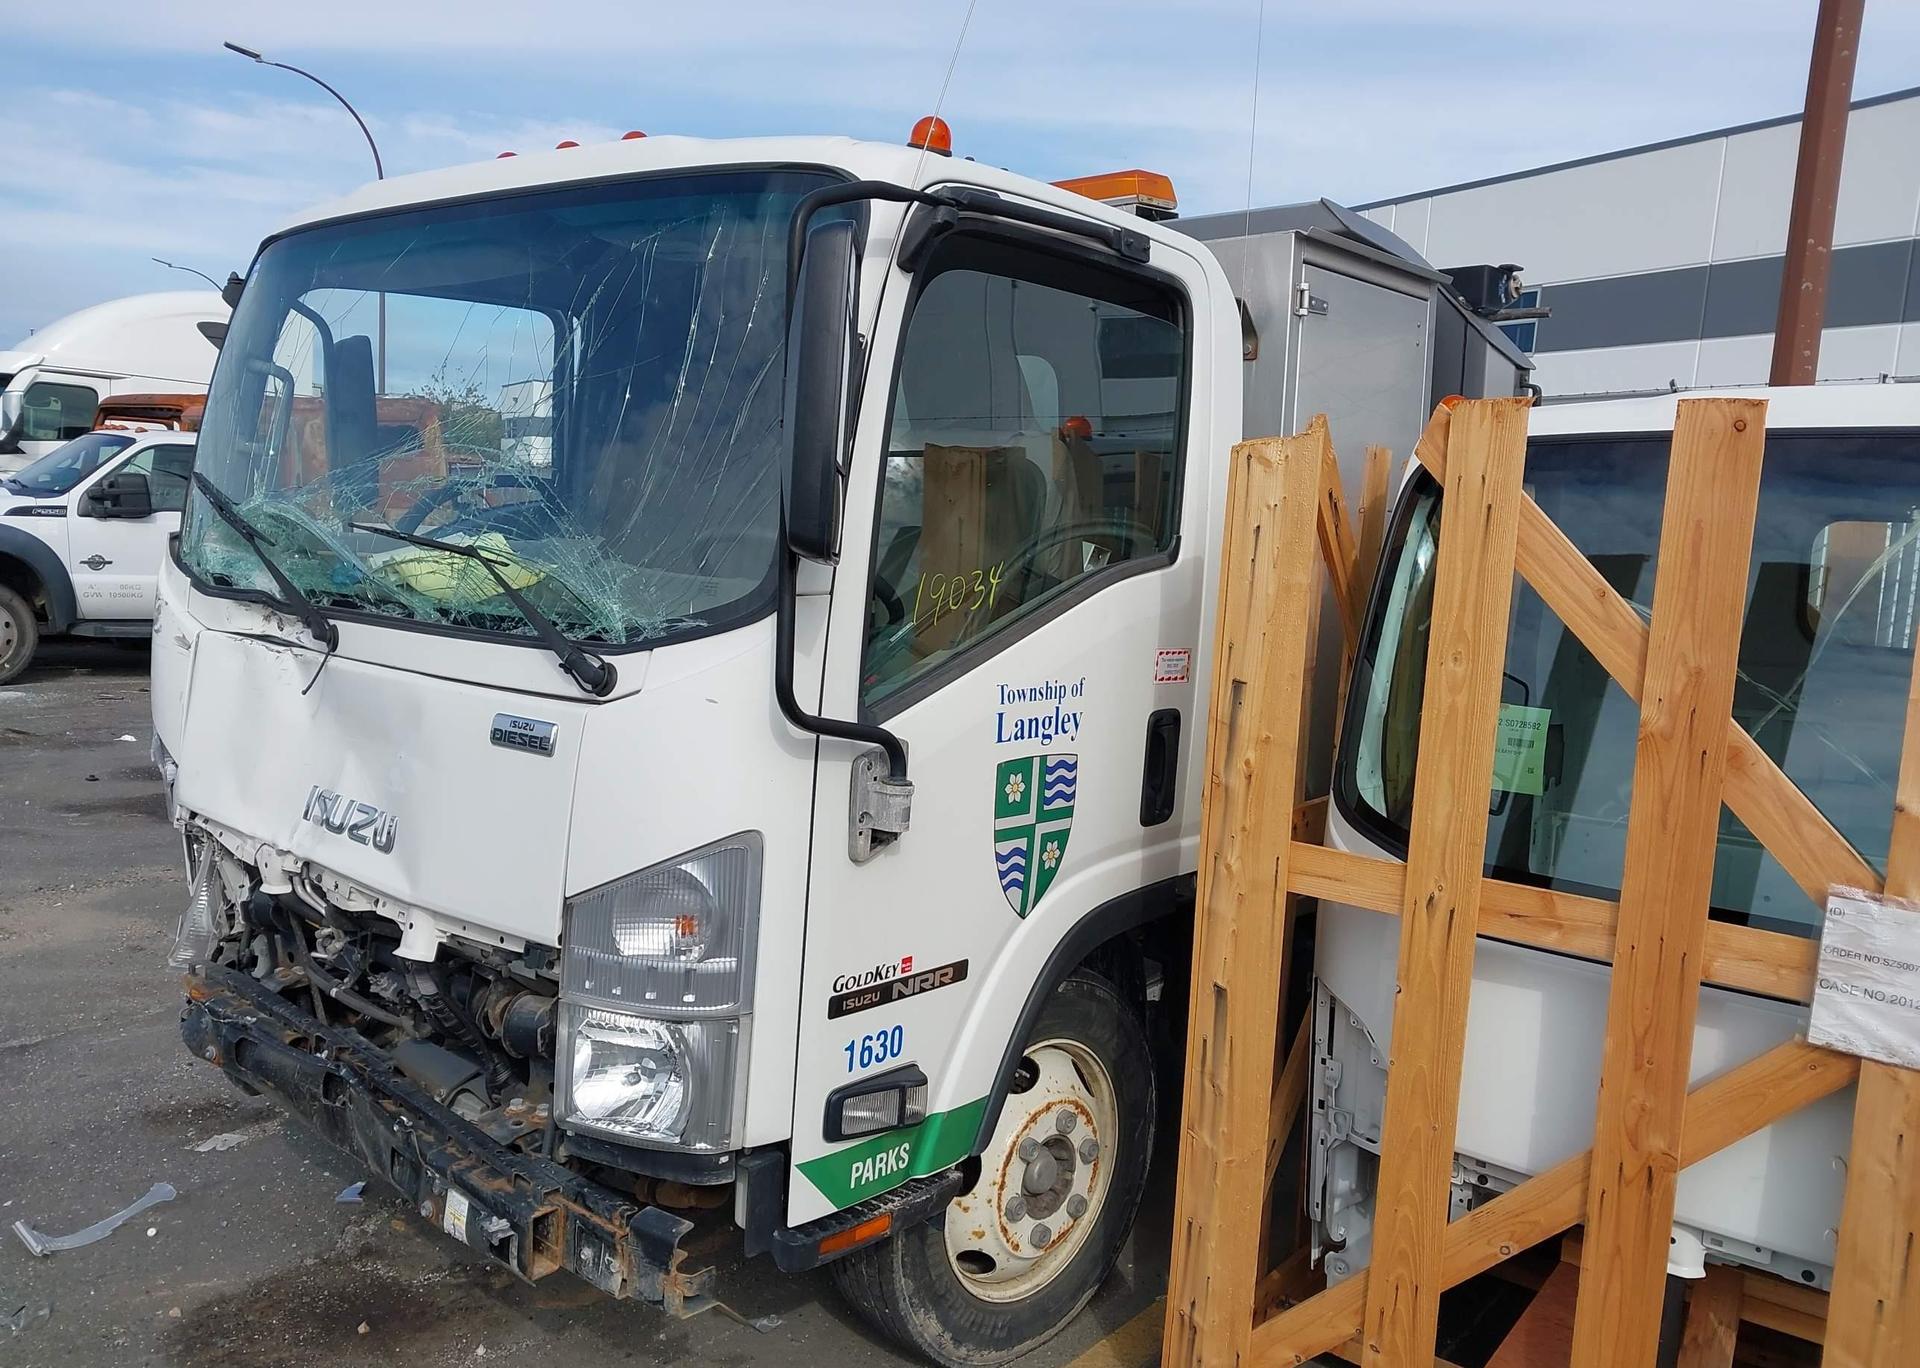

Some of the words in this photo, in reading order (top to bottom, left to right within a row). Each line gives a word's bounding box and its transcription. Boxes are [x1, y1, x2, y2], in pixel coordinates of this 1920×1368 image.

[912, 561, 1005, 626] 19034
[996, 680, 1067, 705] Township
[1070, 677, 1086, 698] of
[492, 728, 551, 751] DIESEL
[509, 720, 536, 732] ISUZU
[995, 706, 1084, 746] Langley
[302, 784, 399, 855] ISUZU
[1823, 946, 1862, 961] ORDER
[1863, 953, 1920, 973] NO.SZ5007
[842, 991, 881, 1011] ISUZU
[891, 967, 955, 1001] NRR
[1819, 978, 1860, 997] CASE
[843, 1024, 904, 1073] 1630
[850, 1142, 910, 1189] PARKS
